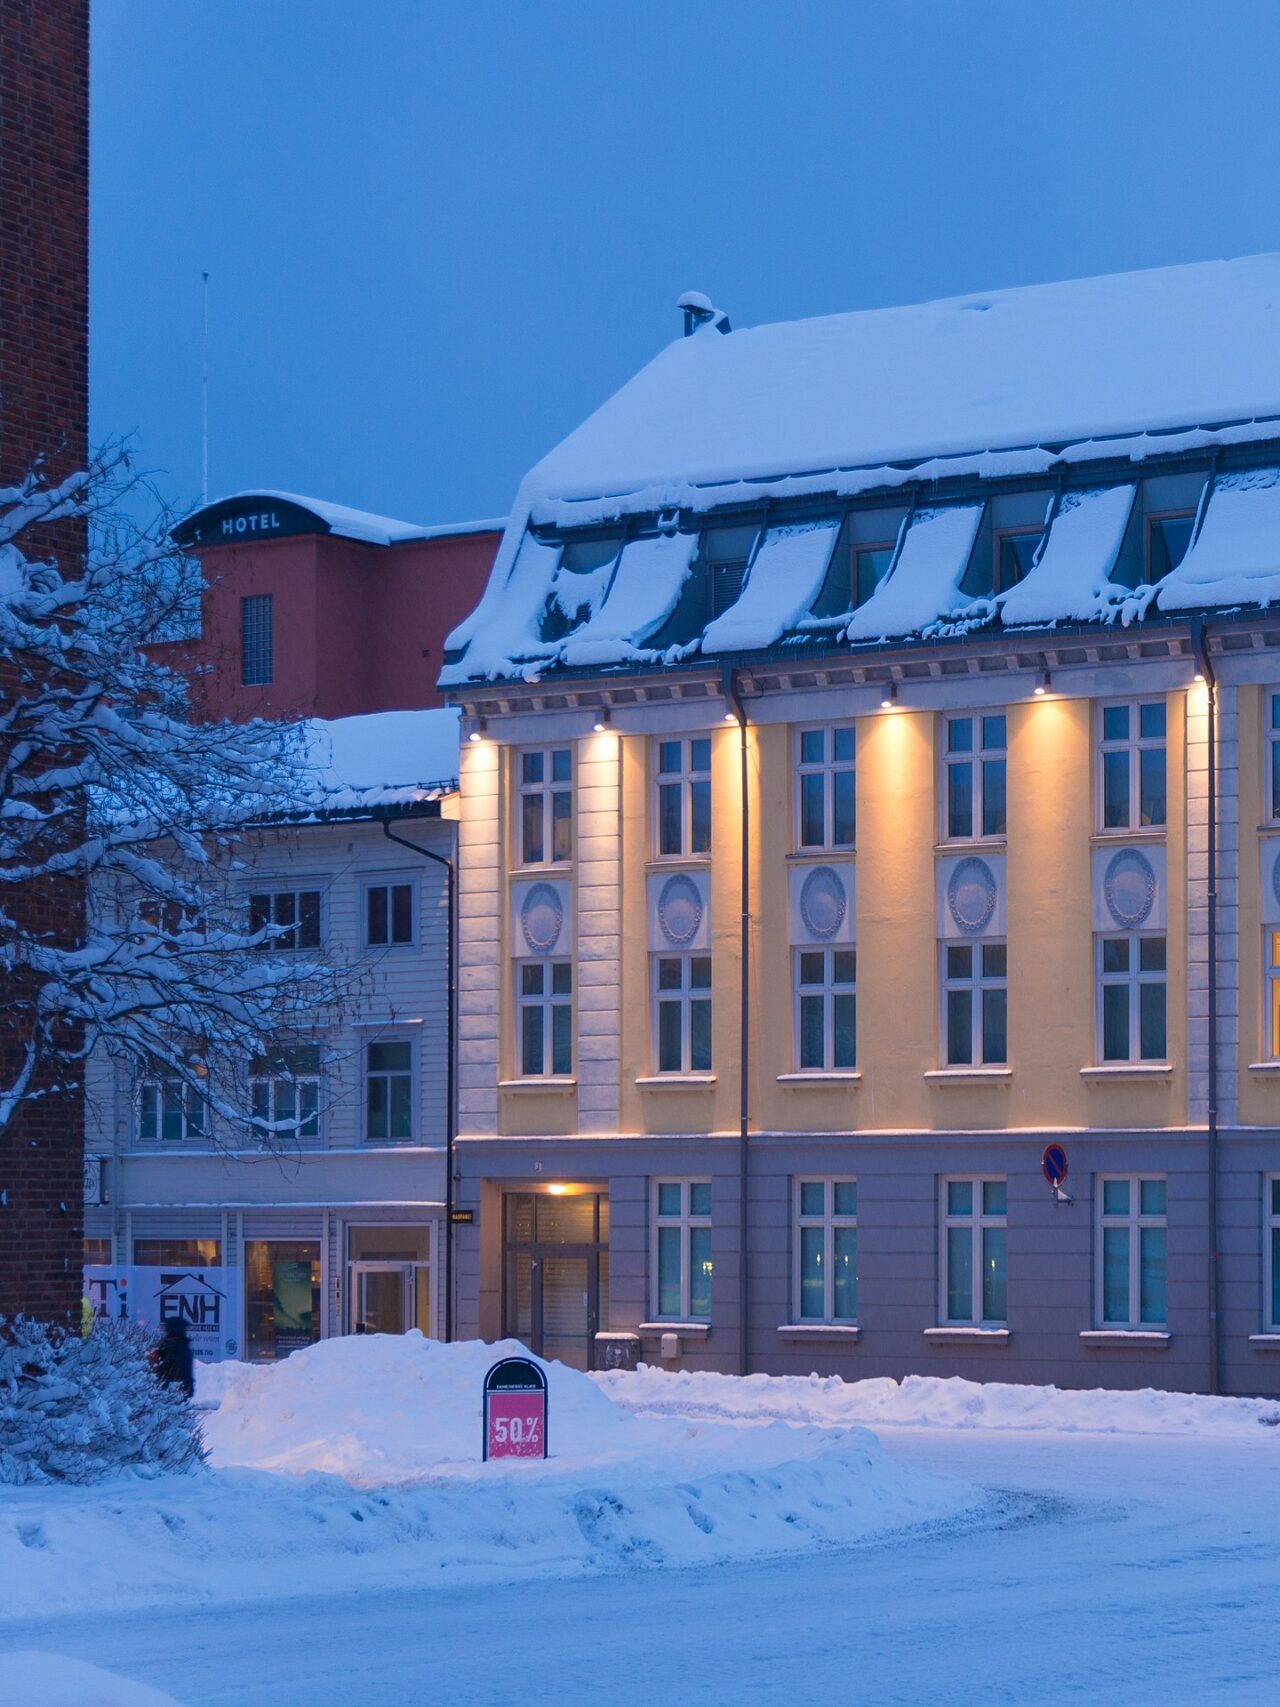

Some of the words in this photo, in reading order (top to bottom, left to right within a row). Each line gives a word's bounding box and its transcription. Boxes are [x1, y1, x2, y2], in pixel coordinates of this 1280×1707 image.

[222, 513, 280, 534] HOTEL
[160, 1294, 220, 1323] ENH
[495, 1417, 538, 1443] 50%
